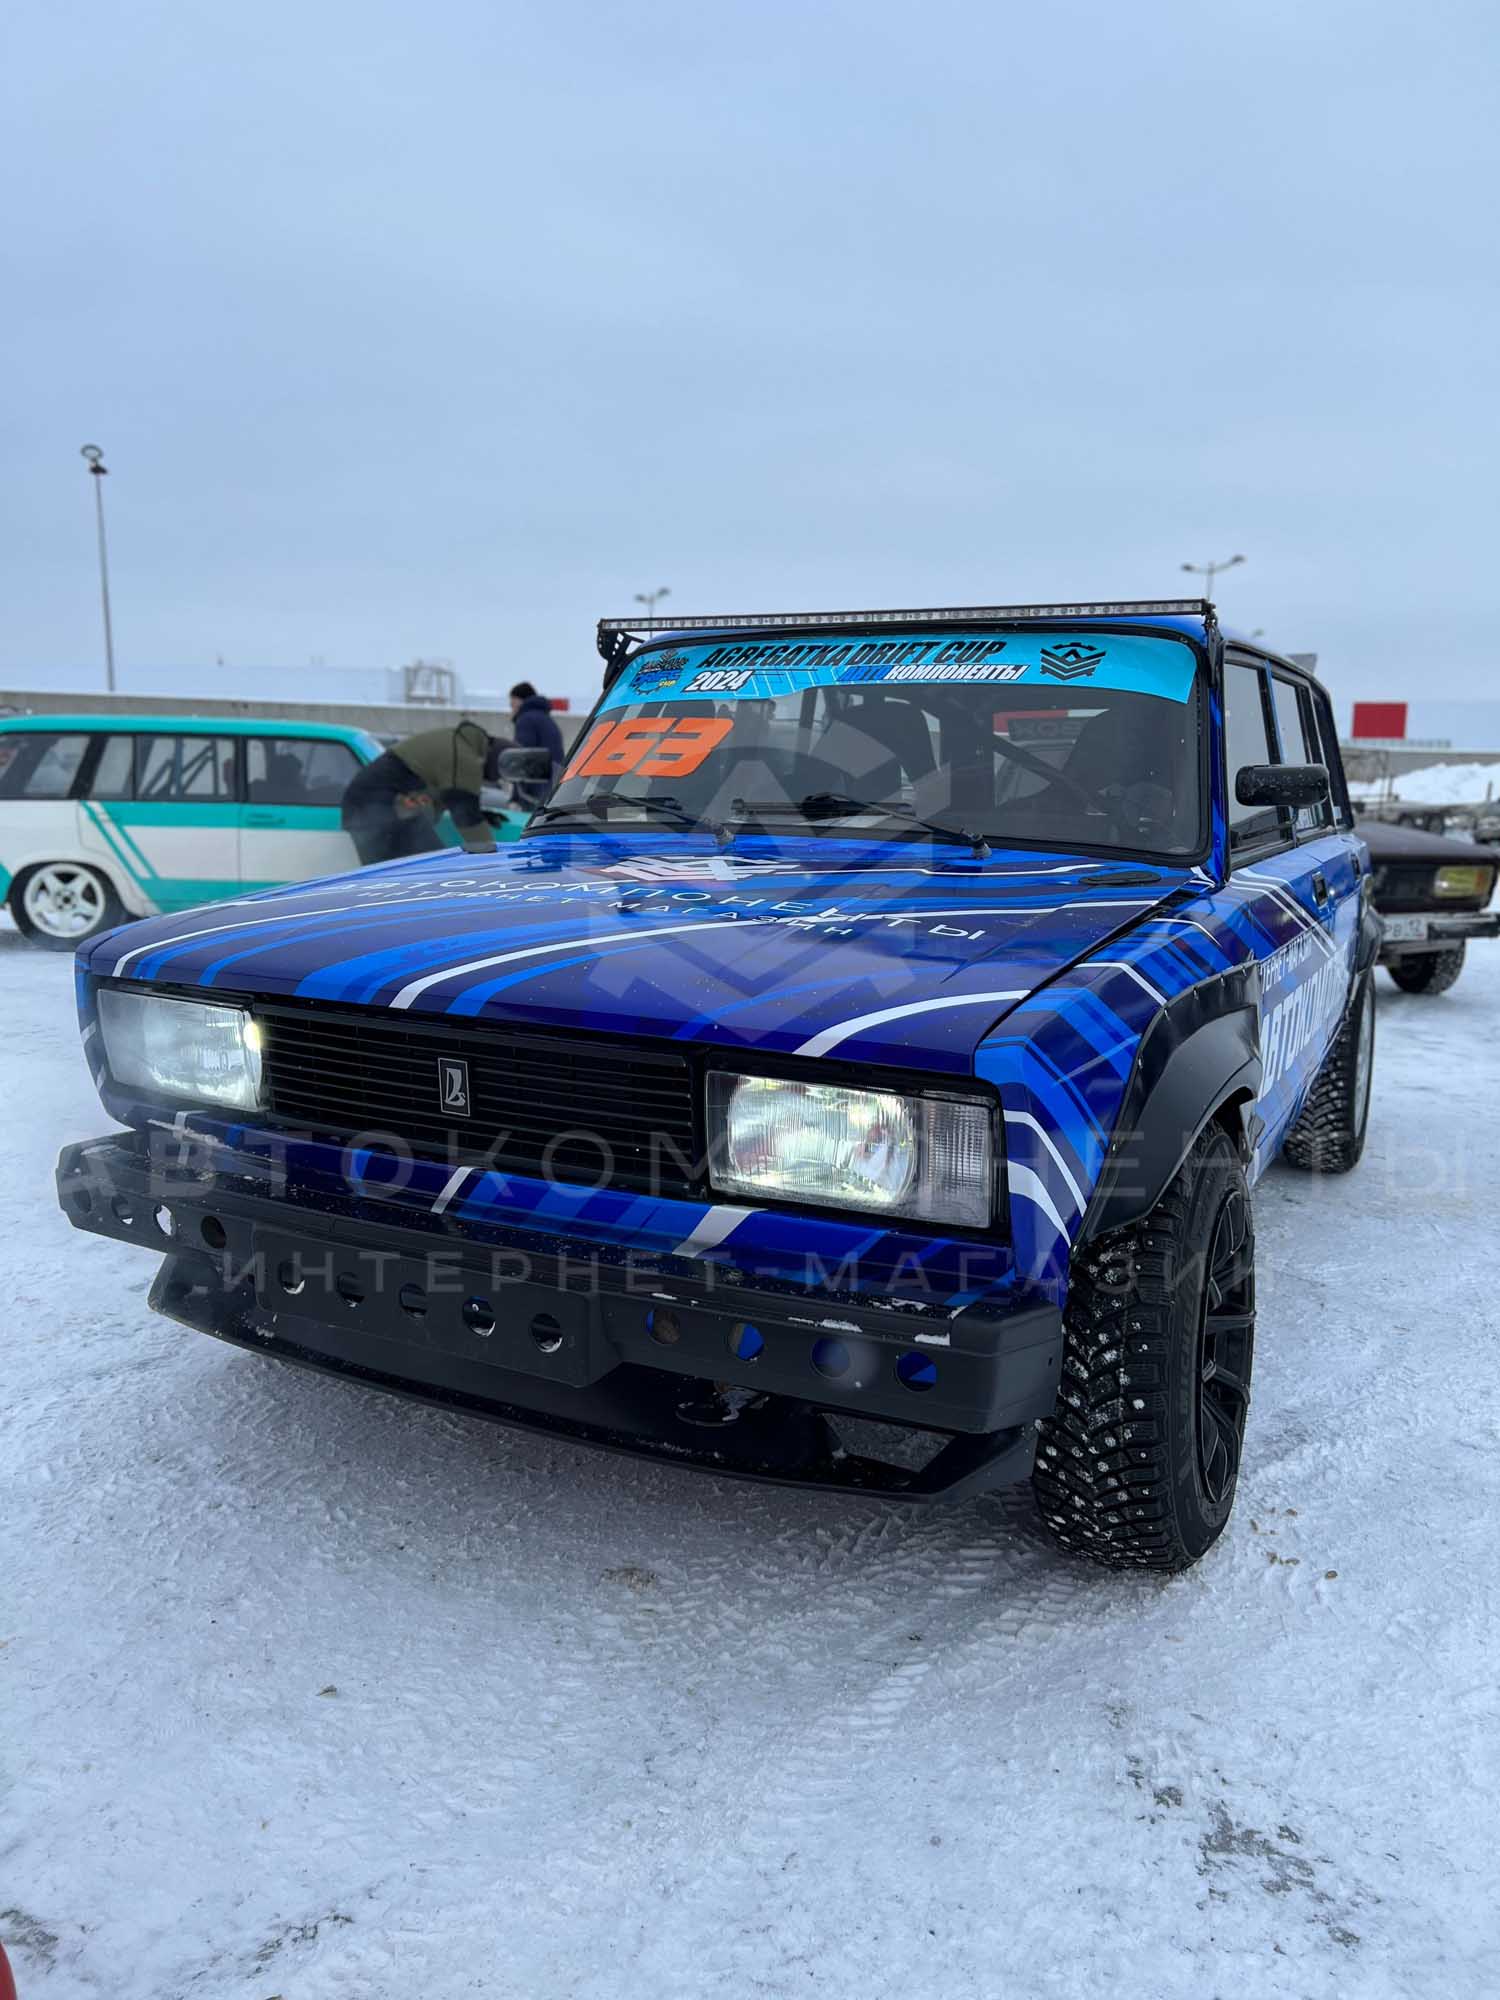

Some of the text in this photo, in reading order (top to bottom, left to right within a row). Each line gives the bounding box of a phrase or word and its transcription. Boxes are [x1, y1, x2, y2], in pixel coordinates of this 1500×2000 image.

[697, 642, 846, 668] AGREGATKA
[846, 641, 939, 666] DRIFT
[932, 640, 1007, 665] CUP
[682, 669, 757, 692] 2024
[559, 716, 734, 784] 163
